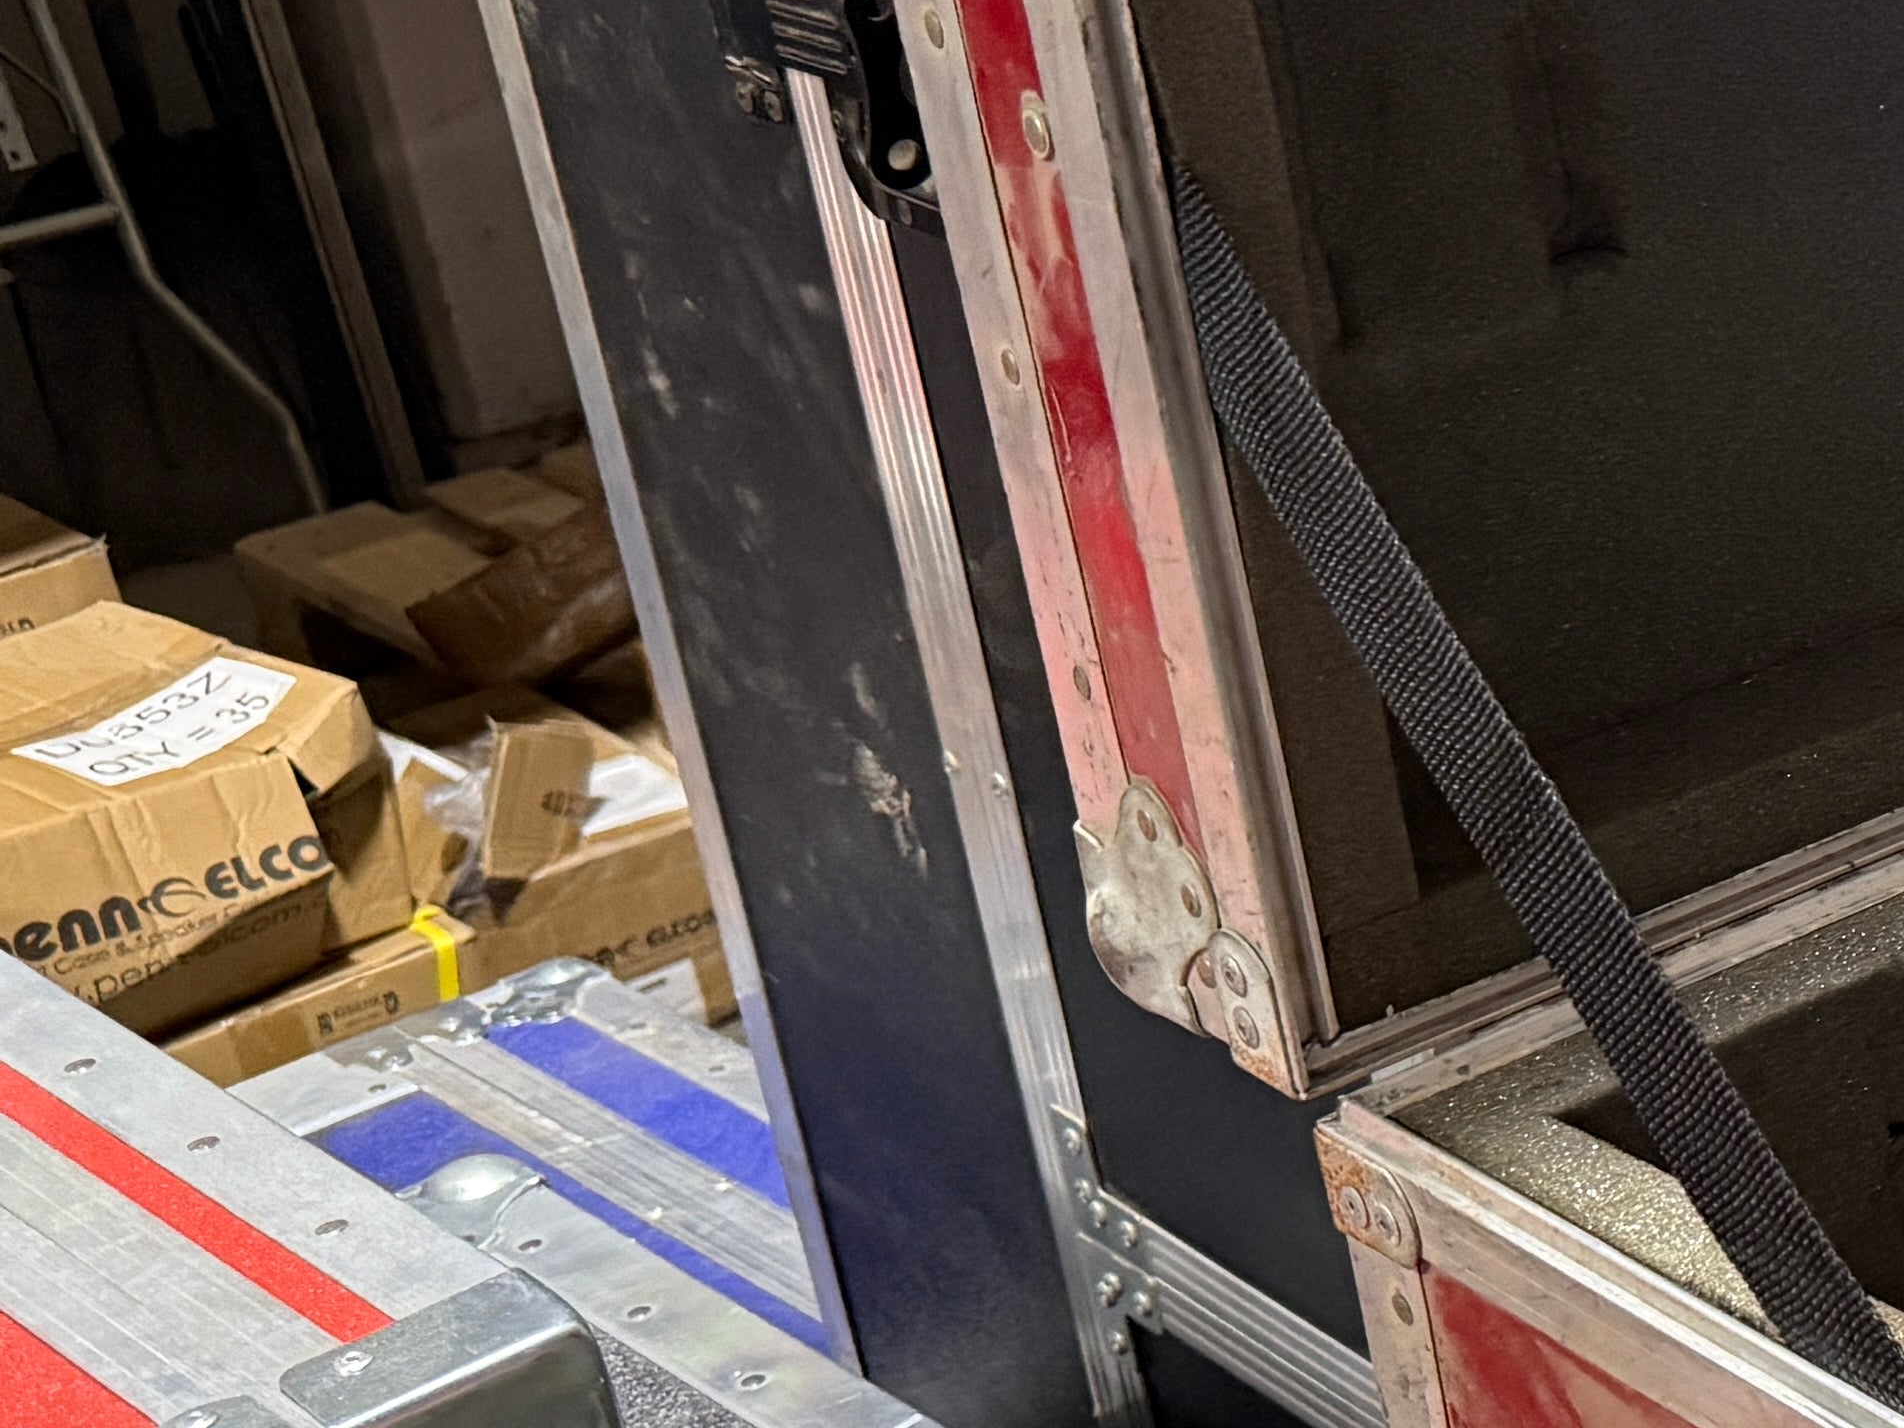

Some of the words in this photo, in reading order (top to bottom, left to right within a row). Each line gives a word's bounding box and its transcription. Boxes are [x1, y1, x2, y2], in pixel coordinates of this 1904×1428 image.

[89, 741, 181, 776] QTY
[215, 691, 272, 724] 35
[0, 897, 142, 962] enn
